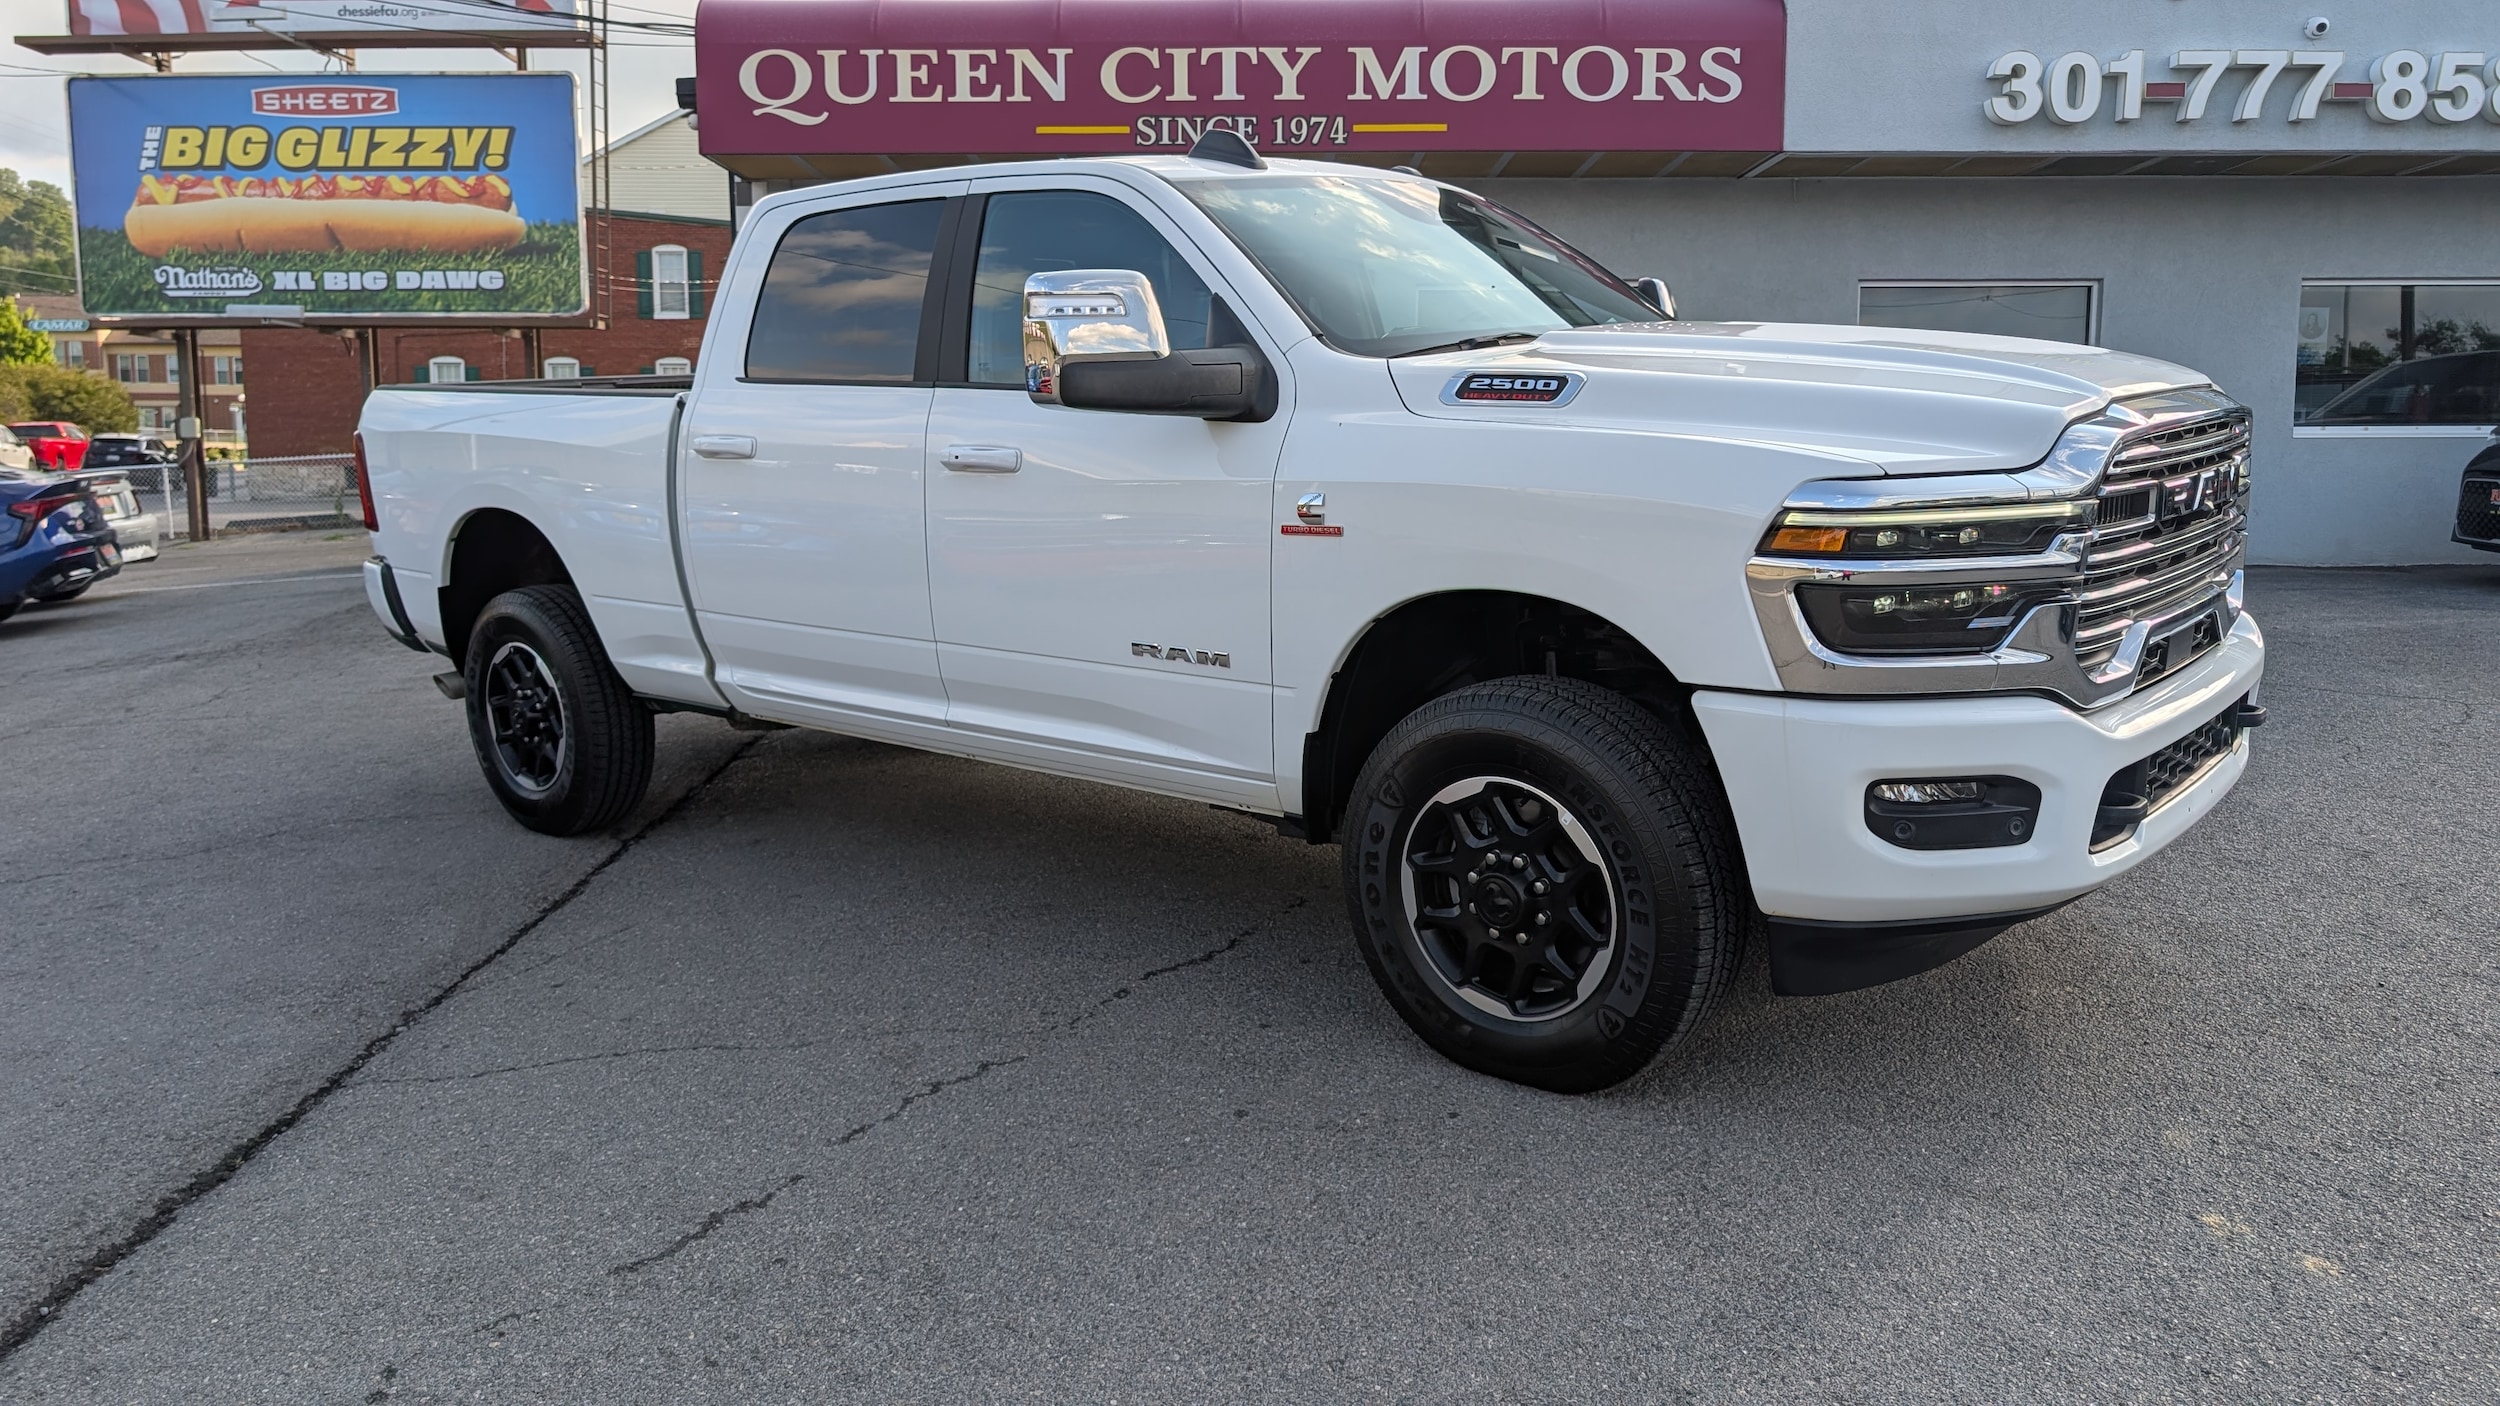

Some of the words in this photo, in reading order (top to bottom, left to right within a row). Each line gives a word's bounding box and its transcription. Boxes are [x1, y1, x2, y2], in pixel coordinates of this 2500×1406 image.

[337, 5, 419, 20] chessiefcu.org
[738, 47, 1073, 126] QUEEN
[1100, 46, 1322, 104] CITY
[1347, 45, 1744, 104] MOTORS
[1983, 49, 2500, 125] 301-777-85
[261, 91, 389, 112] SHEETZ
[1272, 115, 1349, 145] 1974
[138, 126, 162, 171] THE
[160, 126, 270, 168] BIG
[275, 126, 512, 169] GLIZZY!
[153, 265, 262, 290] Nathan's
[272, 270, 317, 291] XL
[322, 270, 389, 291] BIG
[395, 270, 505, 291] DAWG
[32, 320, 84, 331] LAMAR
[1469, 377, 1559, 391] 2500
[1463, 391, 1511, 400] HEAVY
[1512, 391, 1553, 401] DUTY
[1310, 526, 1342, 535] DIESEL
[1130, 641, 1231, 669] RAM
